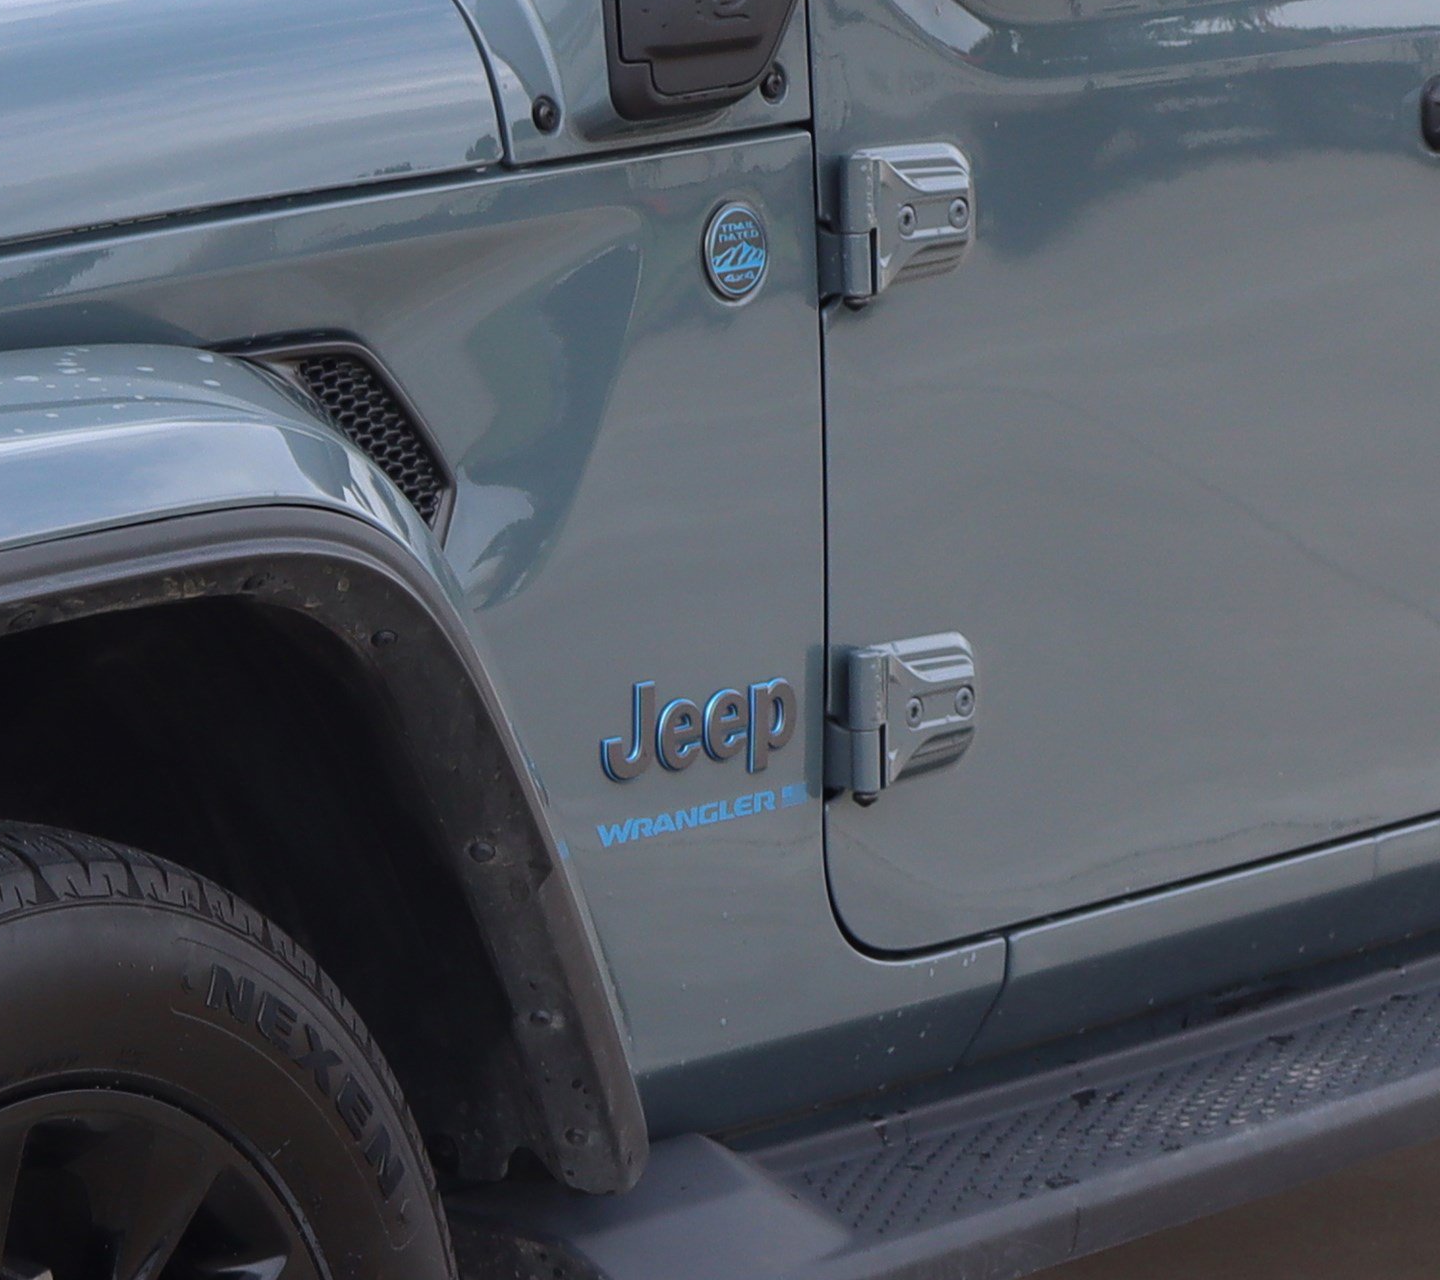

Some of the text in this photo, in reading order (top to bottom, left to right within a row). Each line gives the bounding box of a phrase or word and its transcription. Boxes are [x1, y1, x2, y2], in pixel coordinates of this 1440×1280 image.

[718, 230, 760, 243] RATED
[720, 220, 755, 234] TRAIL
[599, 676, 798, 784] Jeep
[596, 788, 777, 848] WRANGLER
[202, 961, 406, 1203] NEXEN
